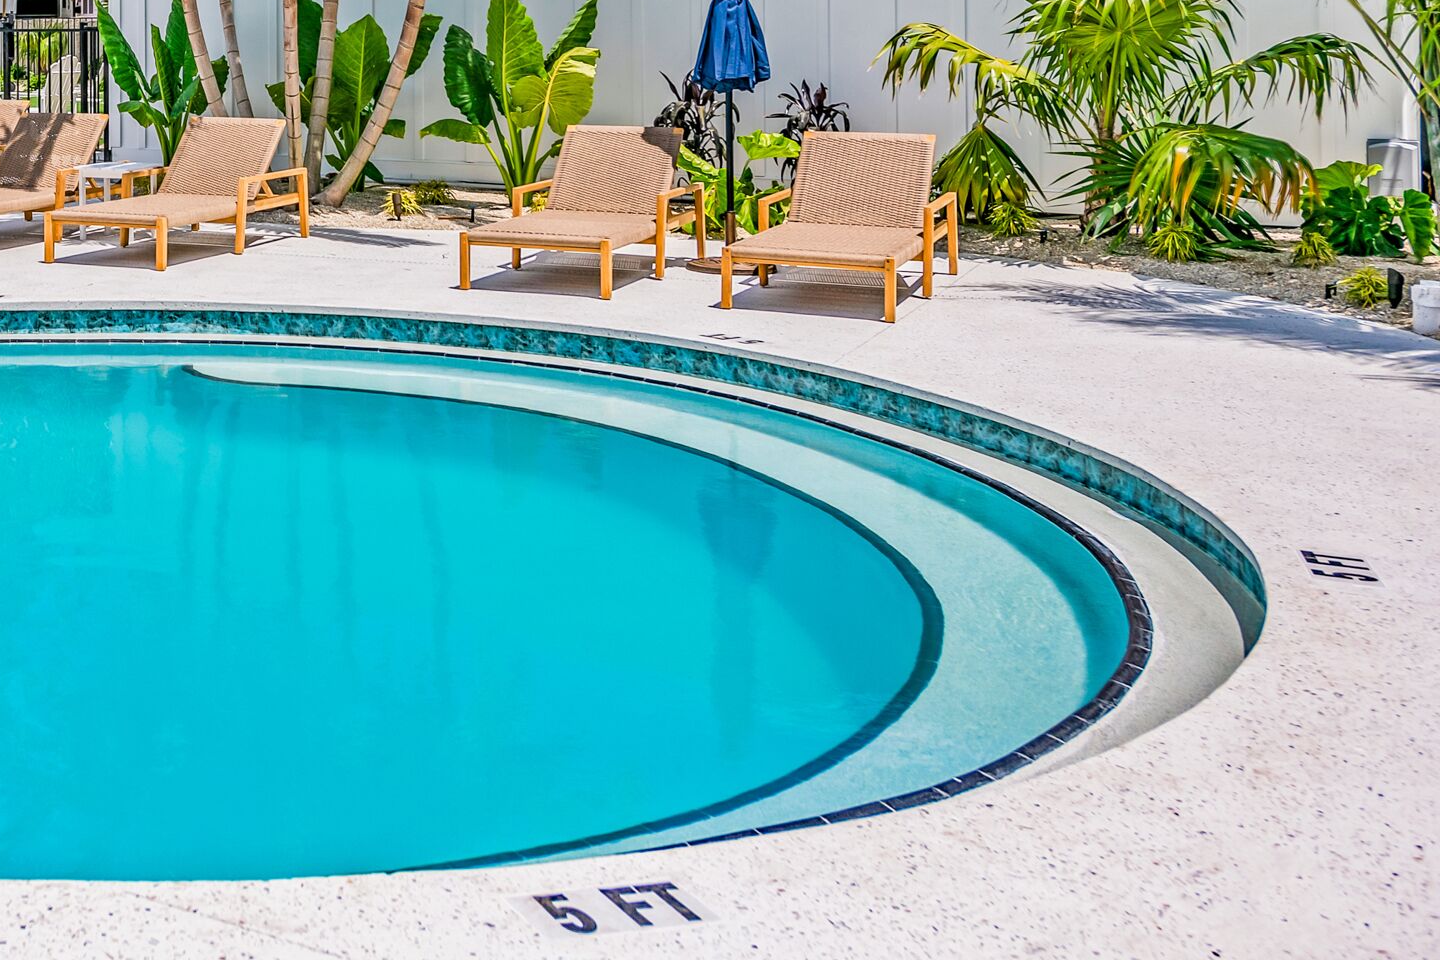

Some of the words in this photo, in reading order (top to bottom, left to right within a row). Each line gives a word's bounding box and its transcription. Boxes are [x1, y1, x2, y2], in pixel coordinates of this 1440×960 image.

[699, 333, 741, 341] FT
[1300, 550, 1371, 571] FT
[1310, 569, 1379, 582] 5
[532, 893, 598, 934] 5
[598, 881, 703, 927] FT
